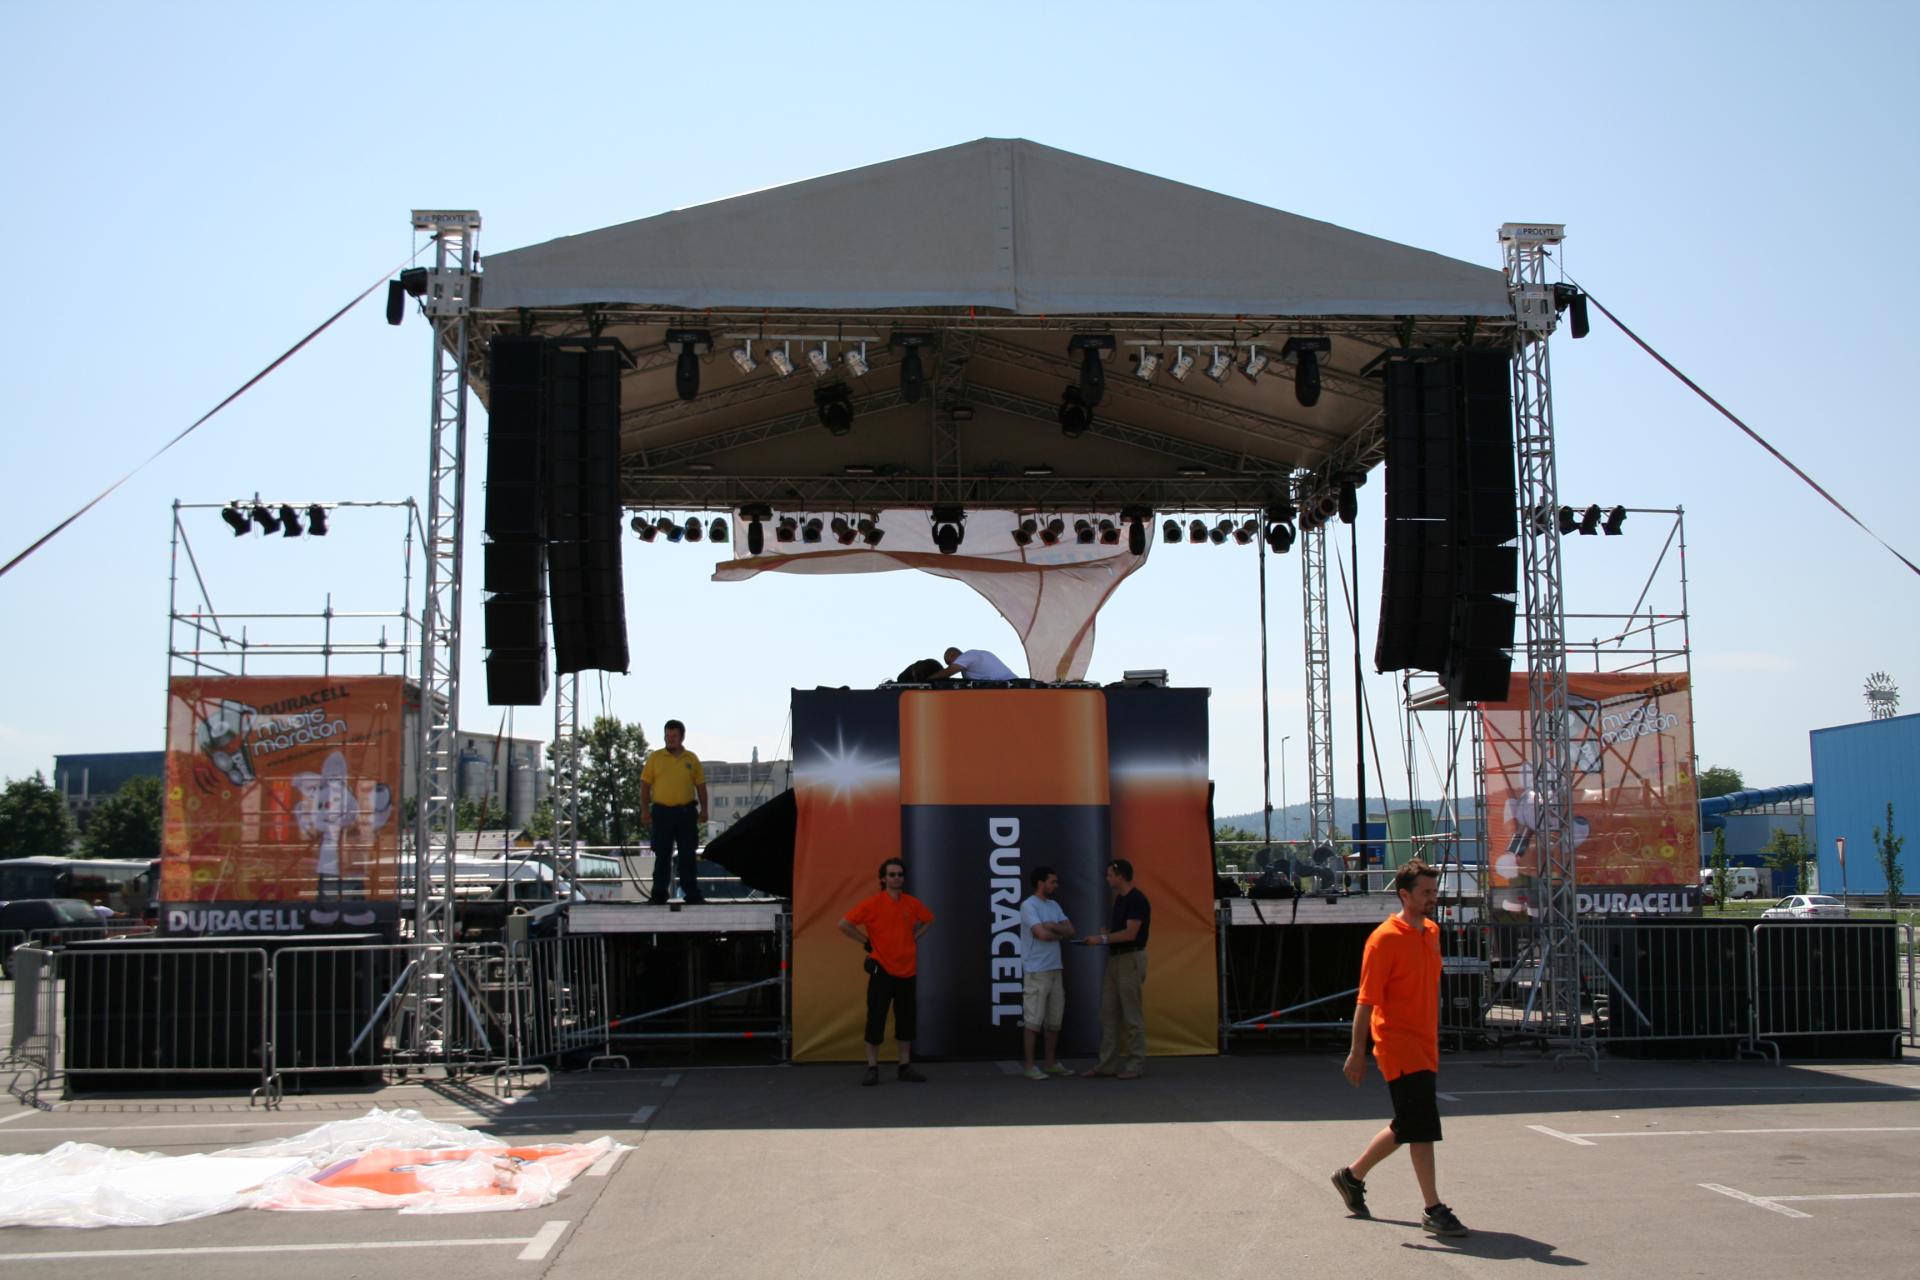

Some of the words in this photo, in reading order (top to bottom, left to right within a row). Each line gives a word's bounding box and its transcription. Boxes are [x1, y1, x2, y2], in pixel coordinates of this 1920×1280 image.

[258, 685, 350, 715] DURACELL
[253, 719, 347, 756] maraton
[1576, 892, 1694, 914] DURACELL
[168, 908, 305, 932] DURACELL
[989, 817, 1022, 1026] DURACELL
